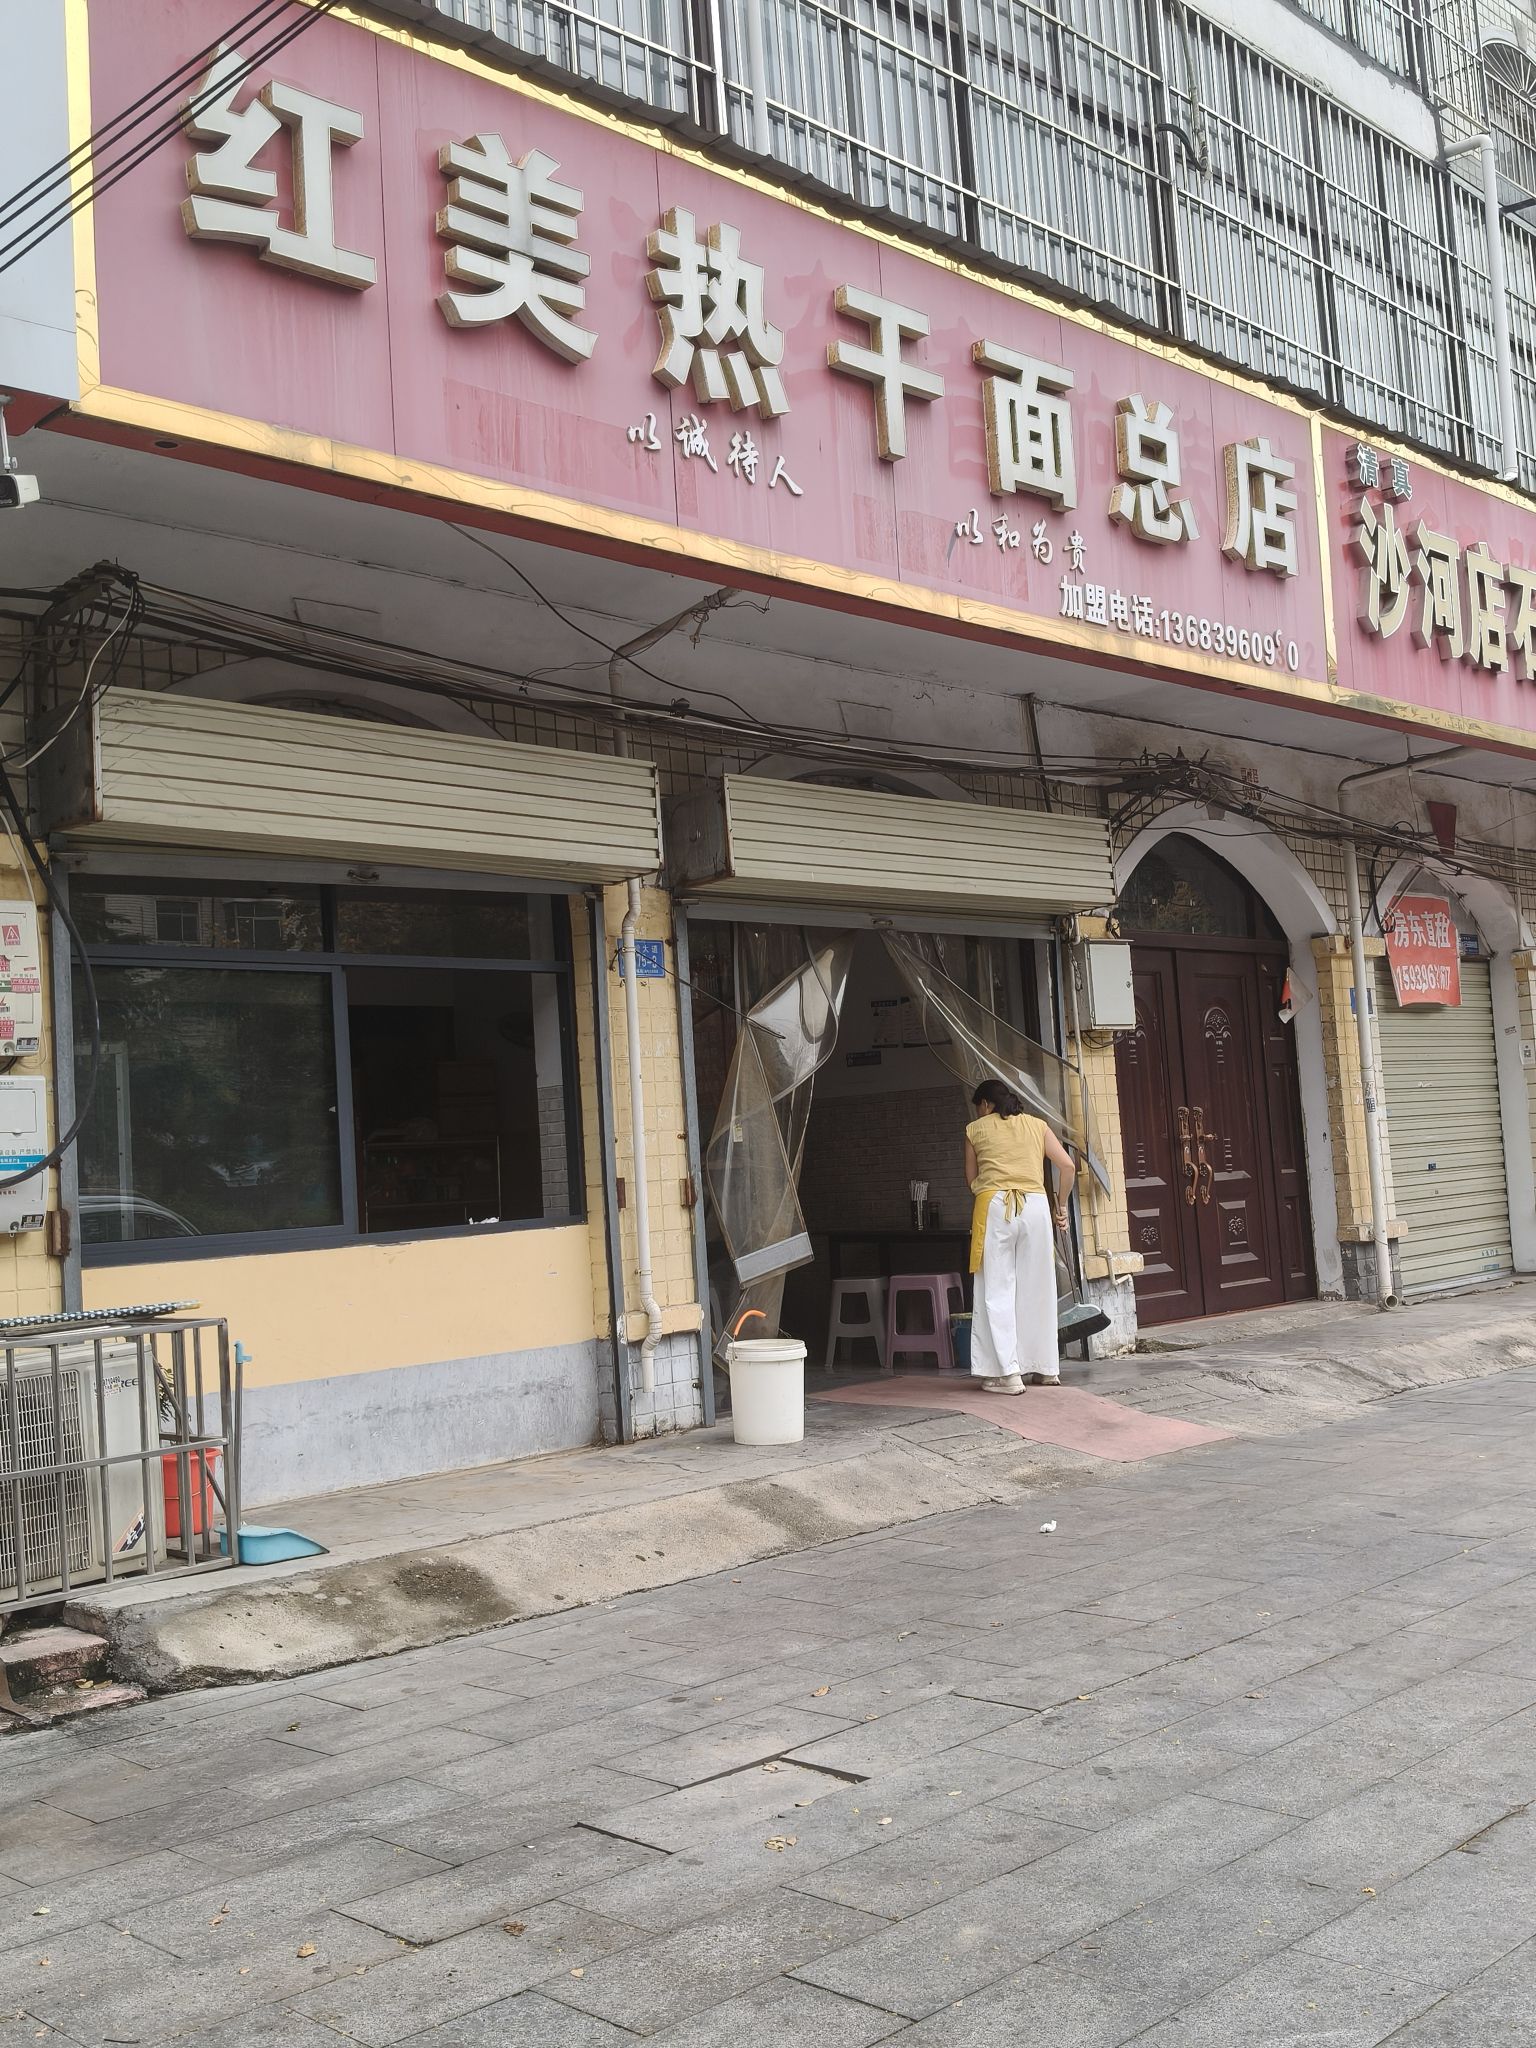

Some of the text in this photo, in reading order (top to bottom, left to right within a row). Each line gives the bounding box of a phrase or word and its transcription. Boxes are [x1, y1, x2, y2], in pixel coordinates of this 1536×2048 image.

[180, 43, 1300, 579] 红美热干面总店
[626, 411, 804, 497] 以诚待人
[1356, 441, 1413, 502] 清真
[953, 507, 1088, 574] 以和为贵
[1060, 574, 1300, 671] 加盟电话:1368396090
[1394, 909, 1451, 949] 房东直租
